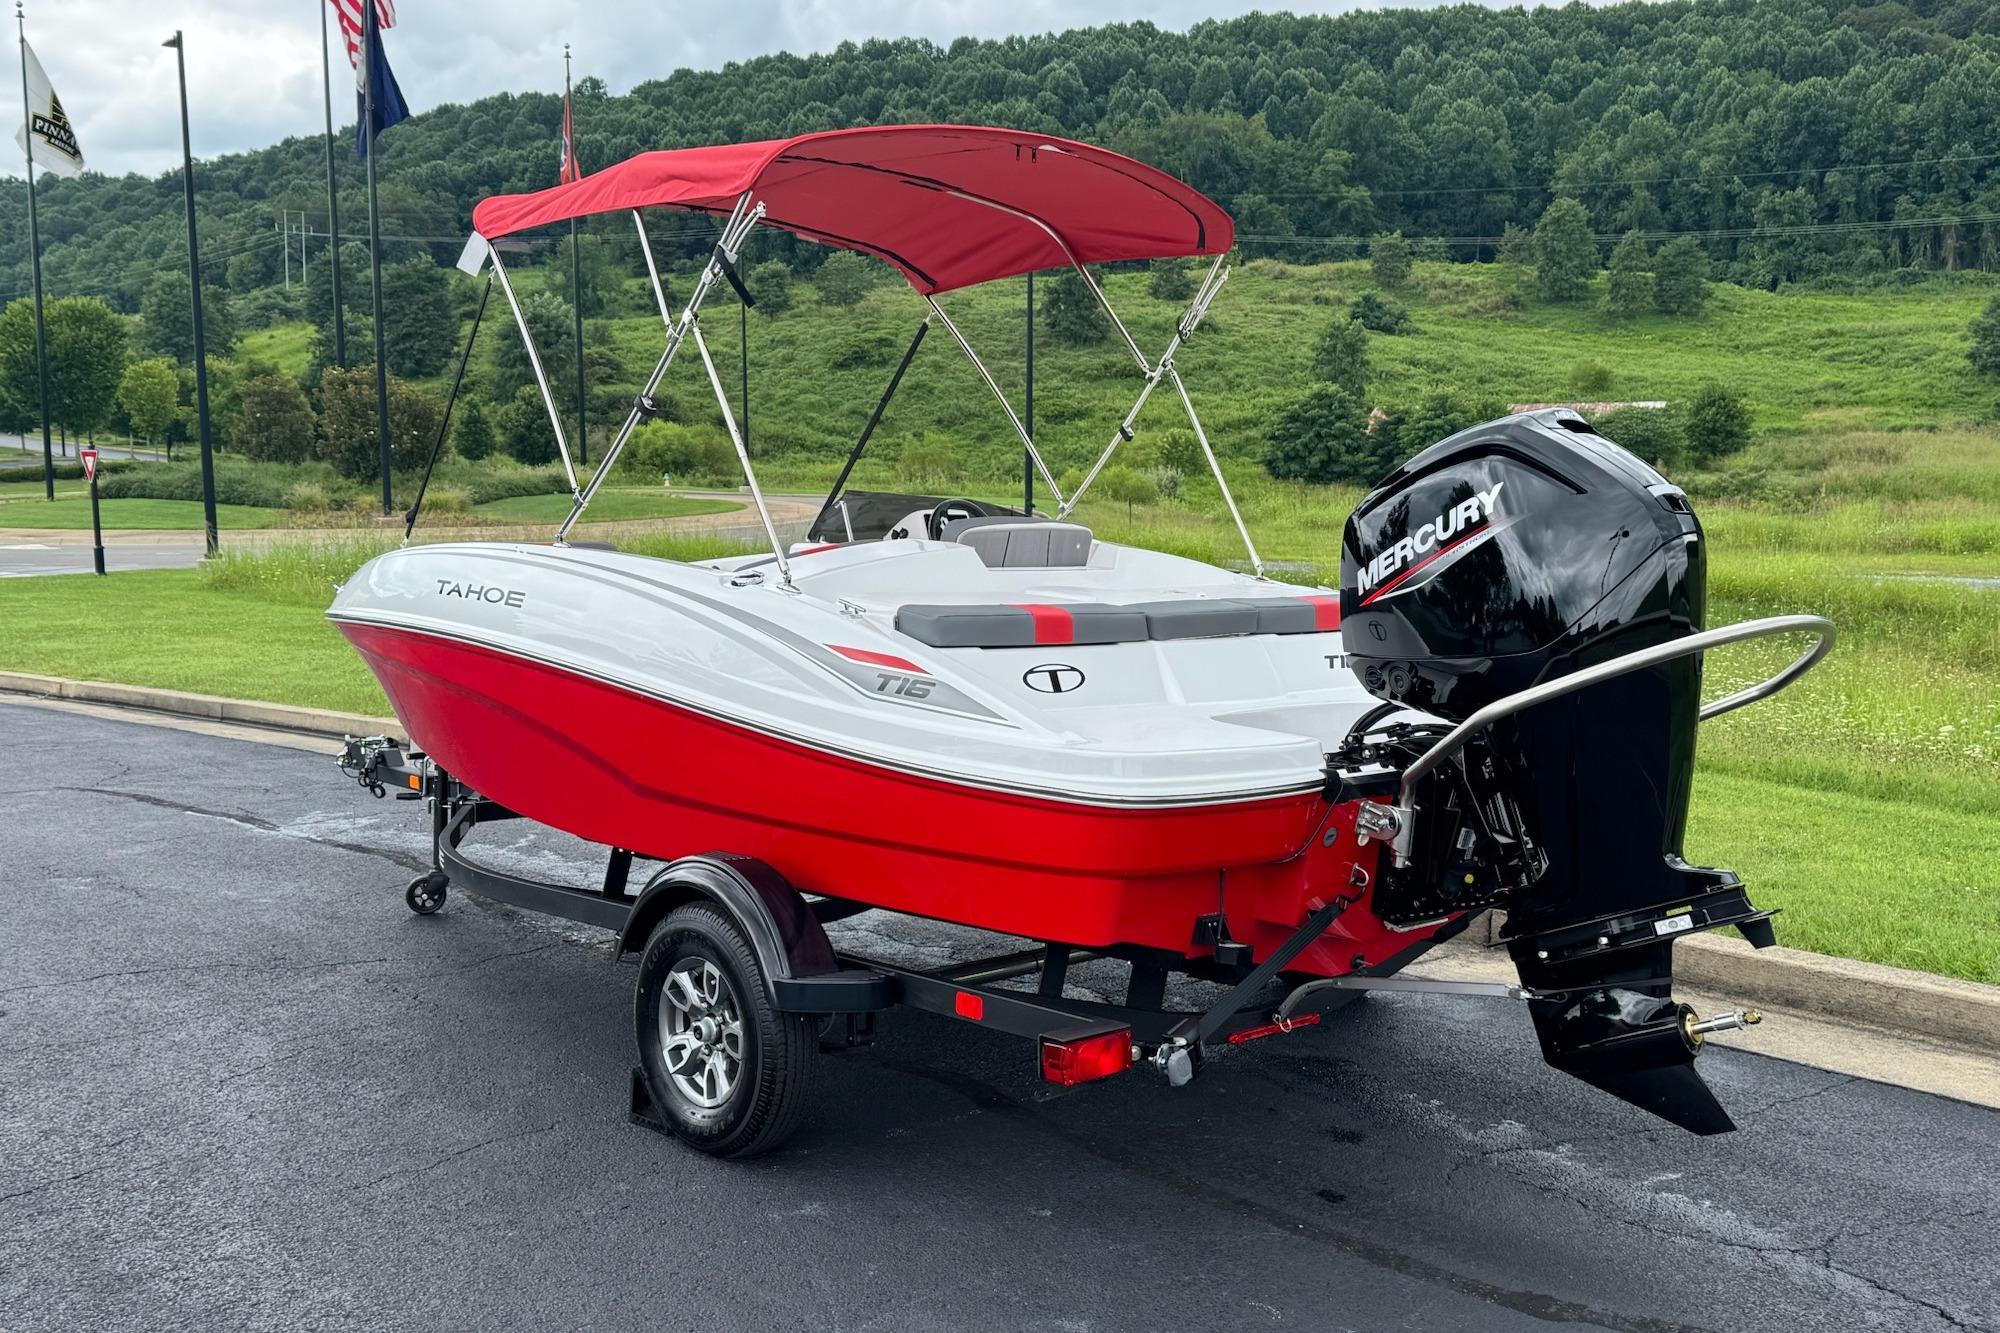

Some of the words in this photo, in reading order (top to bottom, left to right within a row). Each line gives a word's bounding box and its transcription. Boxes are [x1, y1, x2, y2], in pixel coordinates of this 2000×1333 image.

[35, 119, 79, 151] PINNA
[1357, 482, 1504, 596] MERCURY
[437, 579, 526, 608] TAHOE
[1324, 655, 1352, 669] T1
[876, 673, 936, 699] T16
